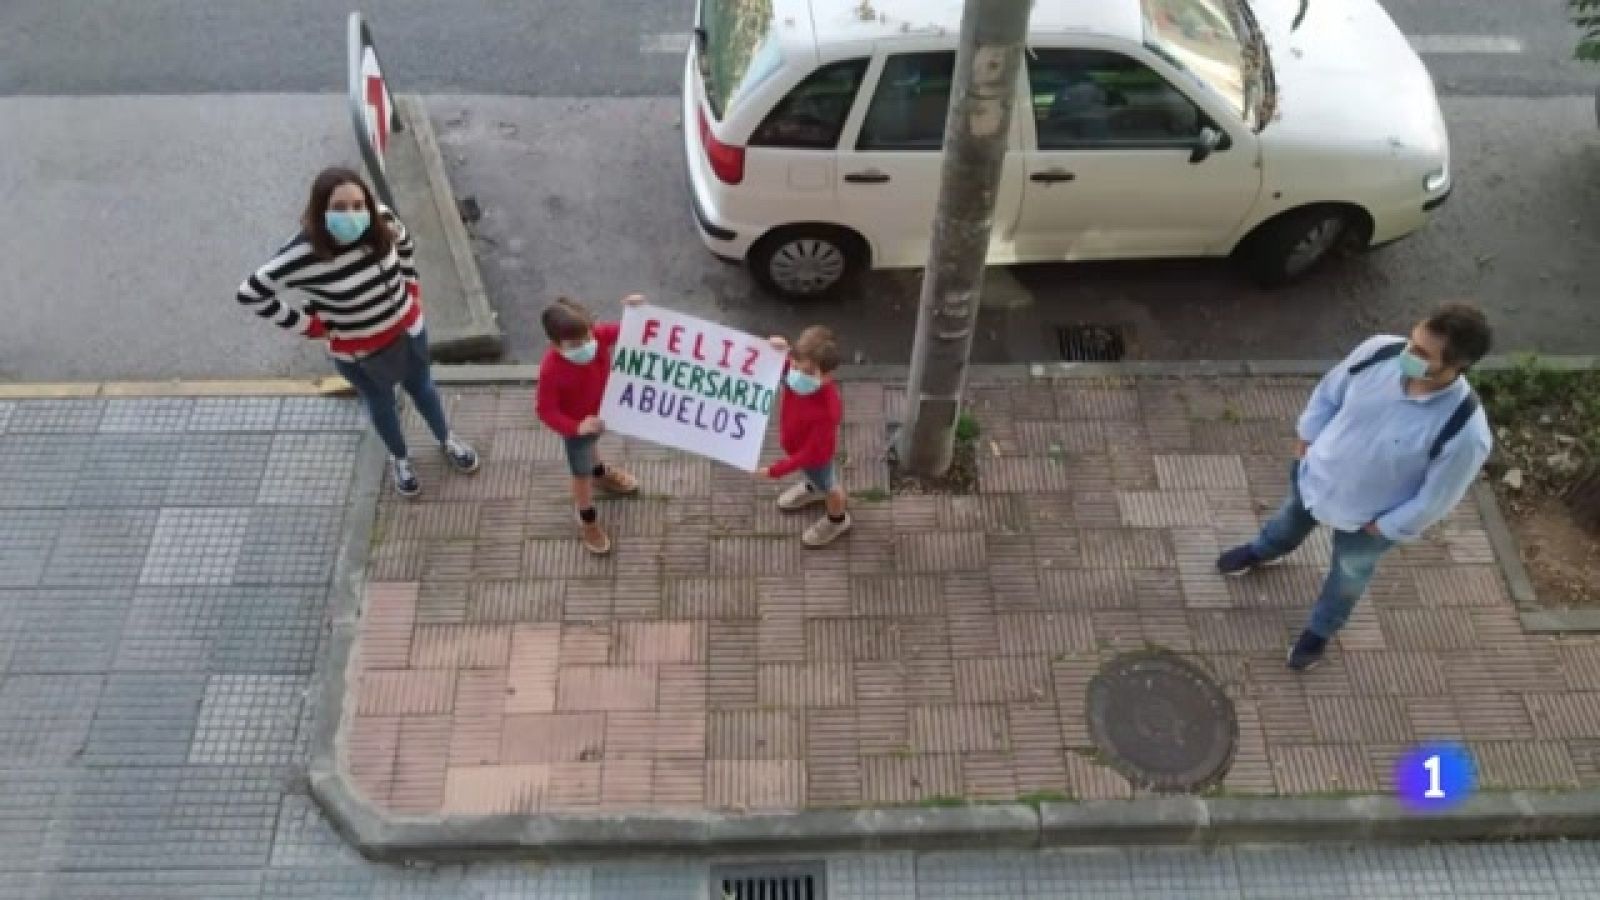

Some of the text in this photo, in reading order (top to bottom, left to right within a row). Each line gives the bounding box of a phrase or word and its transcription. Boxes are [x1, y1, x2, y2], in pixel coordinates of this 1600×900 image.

[641, 319, 760, 376] FELIZ
[612, 347, 773, 415] ANIVERSARIO
[619, 382, 748, 440] ABUELOS
